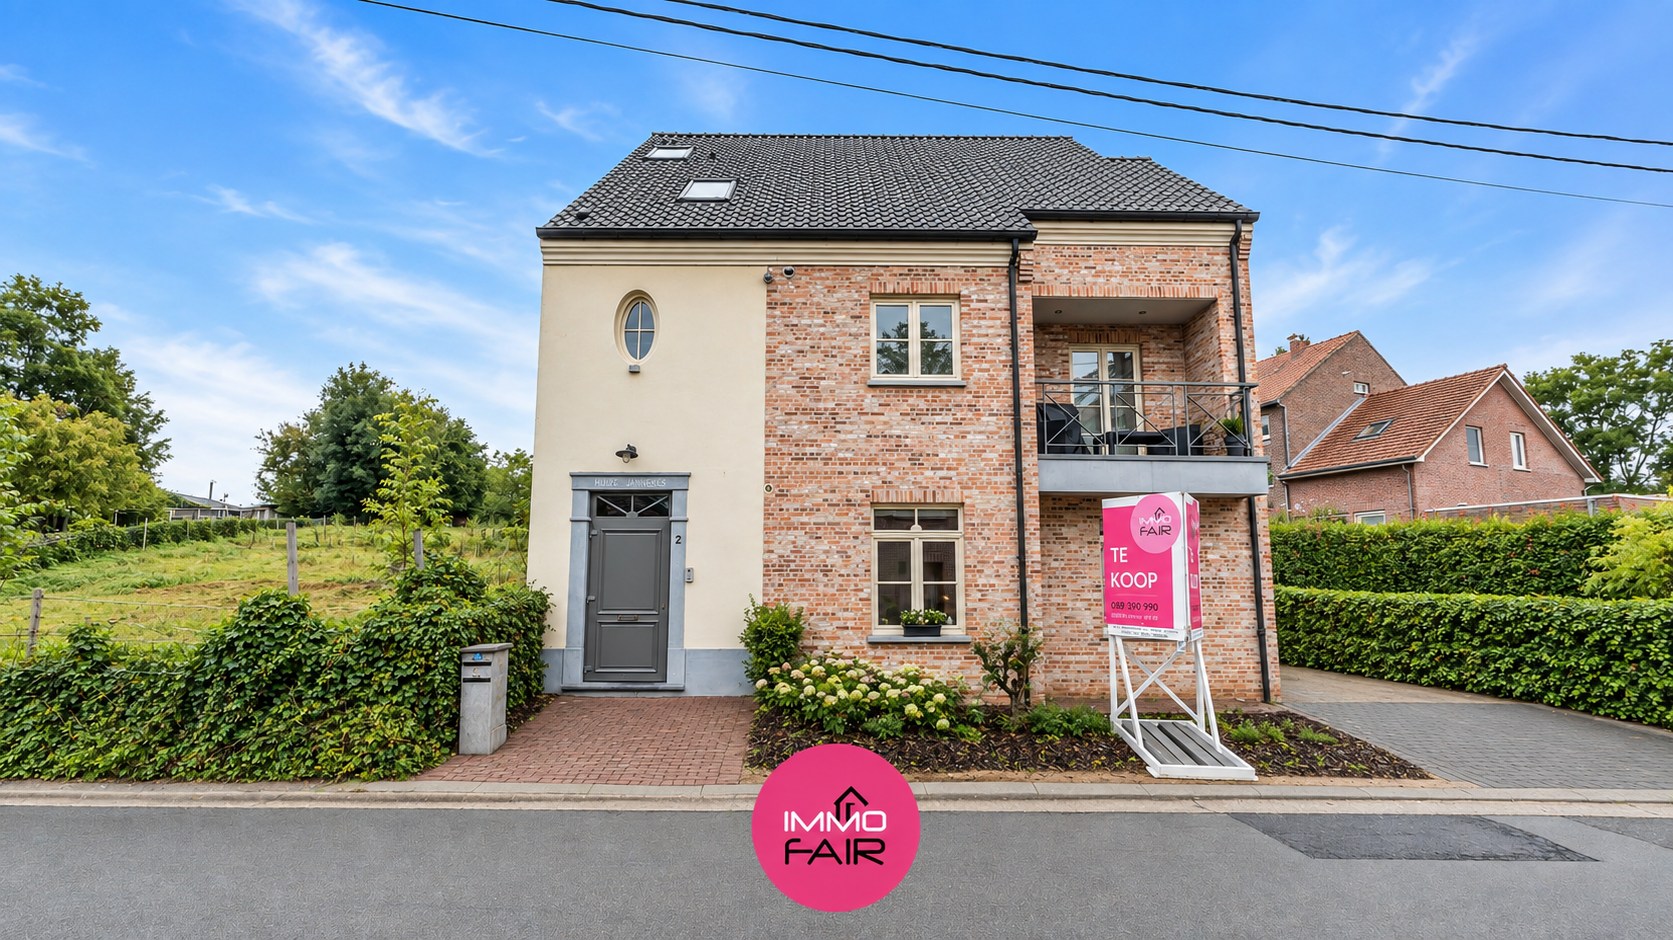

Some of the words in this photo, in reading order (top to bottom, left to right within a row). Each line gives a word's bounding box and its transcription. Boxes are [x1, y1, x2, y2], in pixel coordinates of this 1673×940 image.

[1139, 525, 1172, 536] FAIR
[675, 535, 682, 544] 2
[1110, 547, 1128, 563] TE
[1110, 572, 1158, 588] KOOP
[1143, 603, 1159, 611] 990
